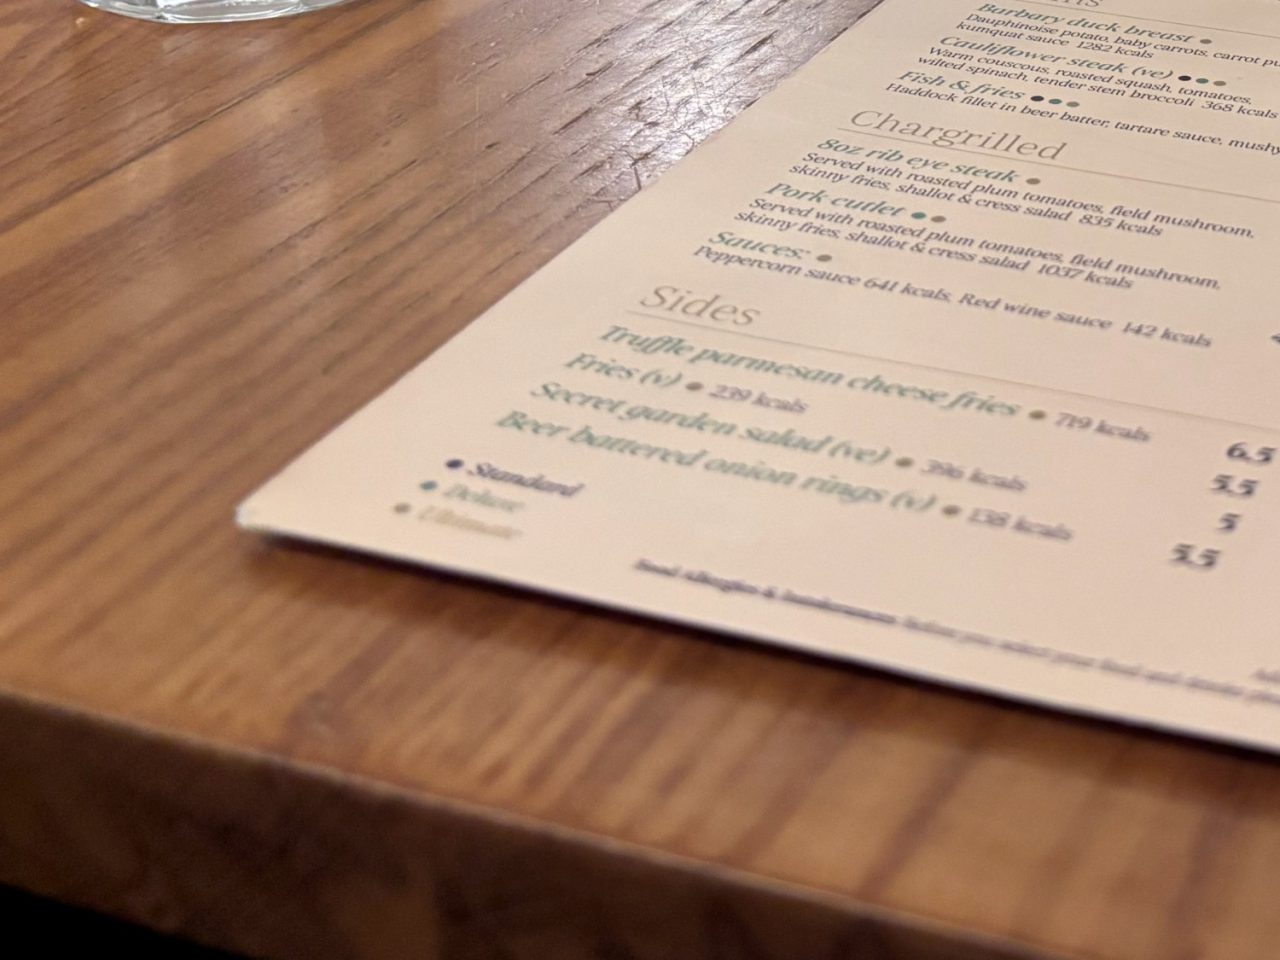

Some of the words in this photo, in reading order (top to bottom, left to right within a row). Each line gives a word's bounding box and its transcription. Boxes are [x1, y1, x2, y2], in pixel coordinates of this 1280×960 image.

[954, 20, 1025, 40] kumquat
[1024, 33, 1070, 46] sauce
[1075, 39, 1113, 53] 1282
[1112, 45, 1154, 59] kcals
[959, 12, 1059, 35] Dauphinoise
[1112, 35, 1153, 50] baby
[1211, 51, 1261, 64] carrot
[975, 2, 1066, 25] Barbary
[1065, 16, 1121, 33] duck
[1122, 24, 1195, 43] breast
[938, 35, 1067, 63] Cauliflower
[1065, 57, 1127, 74] steak
[1130, 65, 1174, 80] (ve)
[896, 70, 946, 87] Fish
[947, 79, 970, 95] &
[963, 82, 1026, 100] fries
[917, 56, 967, 71] wilted
[1032, 74, 1087, 90] tender
[1086, 84, 1126, 97] stem
[1128, 88, 1196, 107] broccoli
[1200, 99, 1235, 112] 368
[1235, 104, 1279, 119] kcals
[849, 109, 1068, 160] Chargrilled
[816, 137, 865, 155] 8oz
[864, 148, 905, 162] rib
[905, 156, 950, 170] eye
[948, 164, 1019, 183] steak
[764, 181, 829, 204] Pork
[829, 196, 906, 217] cutlet
[707, 230, 811, 260] Sauces:
[638, 284, 761, 326] Sides
[562, 351, 640, 380] Fries
[638, 368, 684, 388] (v)
[598, 324, 695, 356] Truffle
[686, 347, 845, 386] parmesan
[845, 373, 949, 409] cheese
[940, 390, 1022, 417] fries
[1224, 441, 1277, 465] 6.5
[1210, 473, 1260, 499] 5.5
[1170, 542, 1222, 571] 5.5
